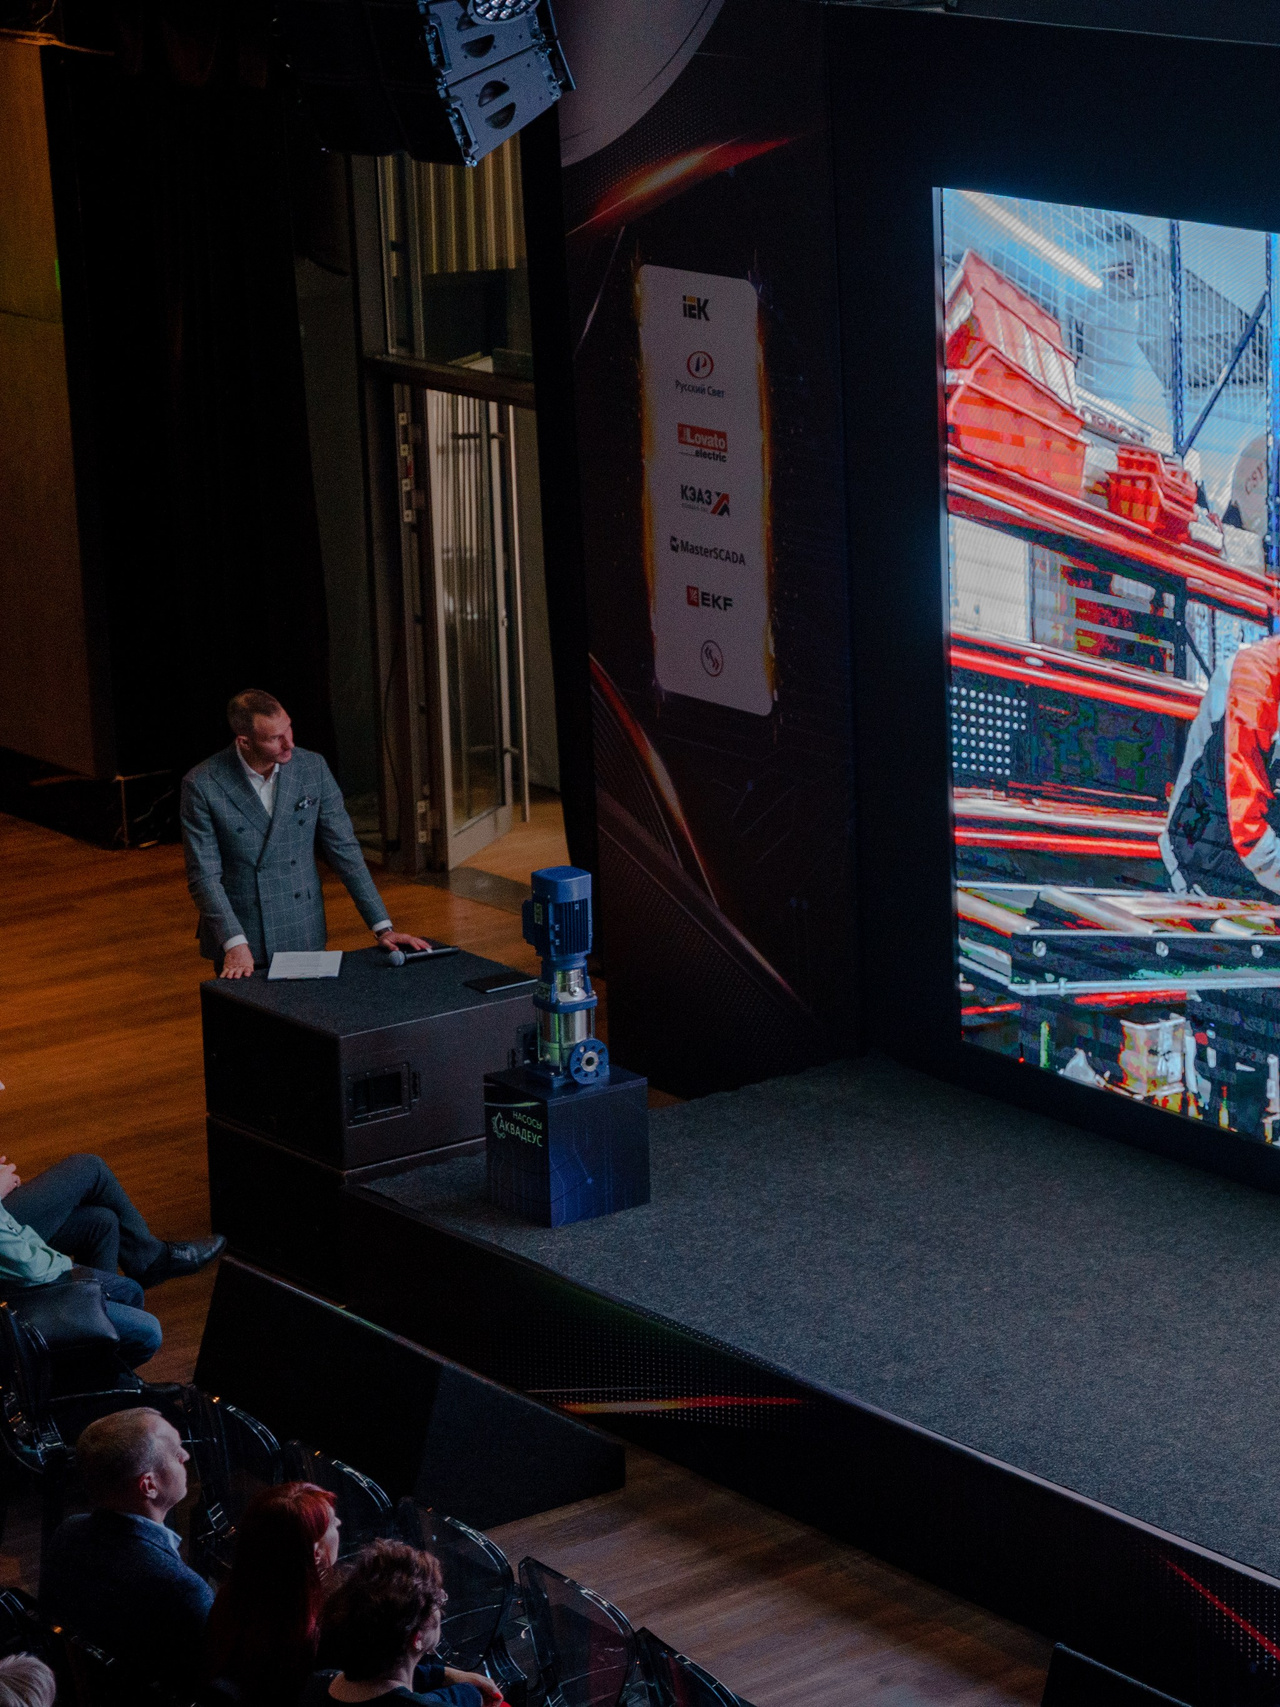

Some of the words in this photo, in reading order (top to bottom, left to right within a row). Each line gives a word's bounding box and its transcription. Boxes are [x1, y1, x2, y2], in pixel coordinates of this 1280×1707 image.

[675, 379, 706, 396] Русский
[707, 386, 725, 398] Свет
[683, 427, 726, 449] Lovato
[695, 449, 727, 463] electric
[681, 484, 712, 506] КЭАЗ
[680, 540, 746, 566] MasterSCADA
[701, 591, 733, 611] EKF
[513, 1110, 543, 1130] НАСОСЫ
[499, 1119, 543, 1147] АКВАДЕУС
